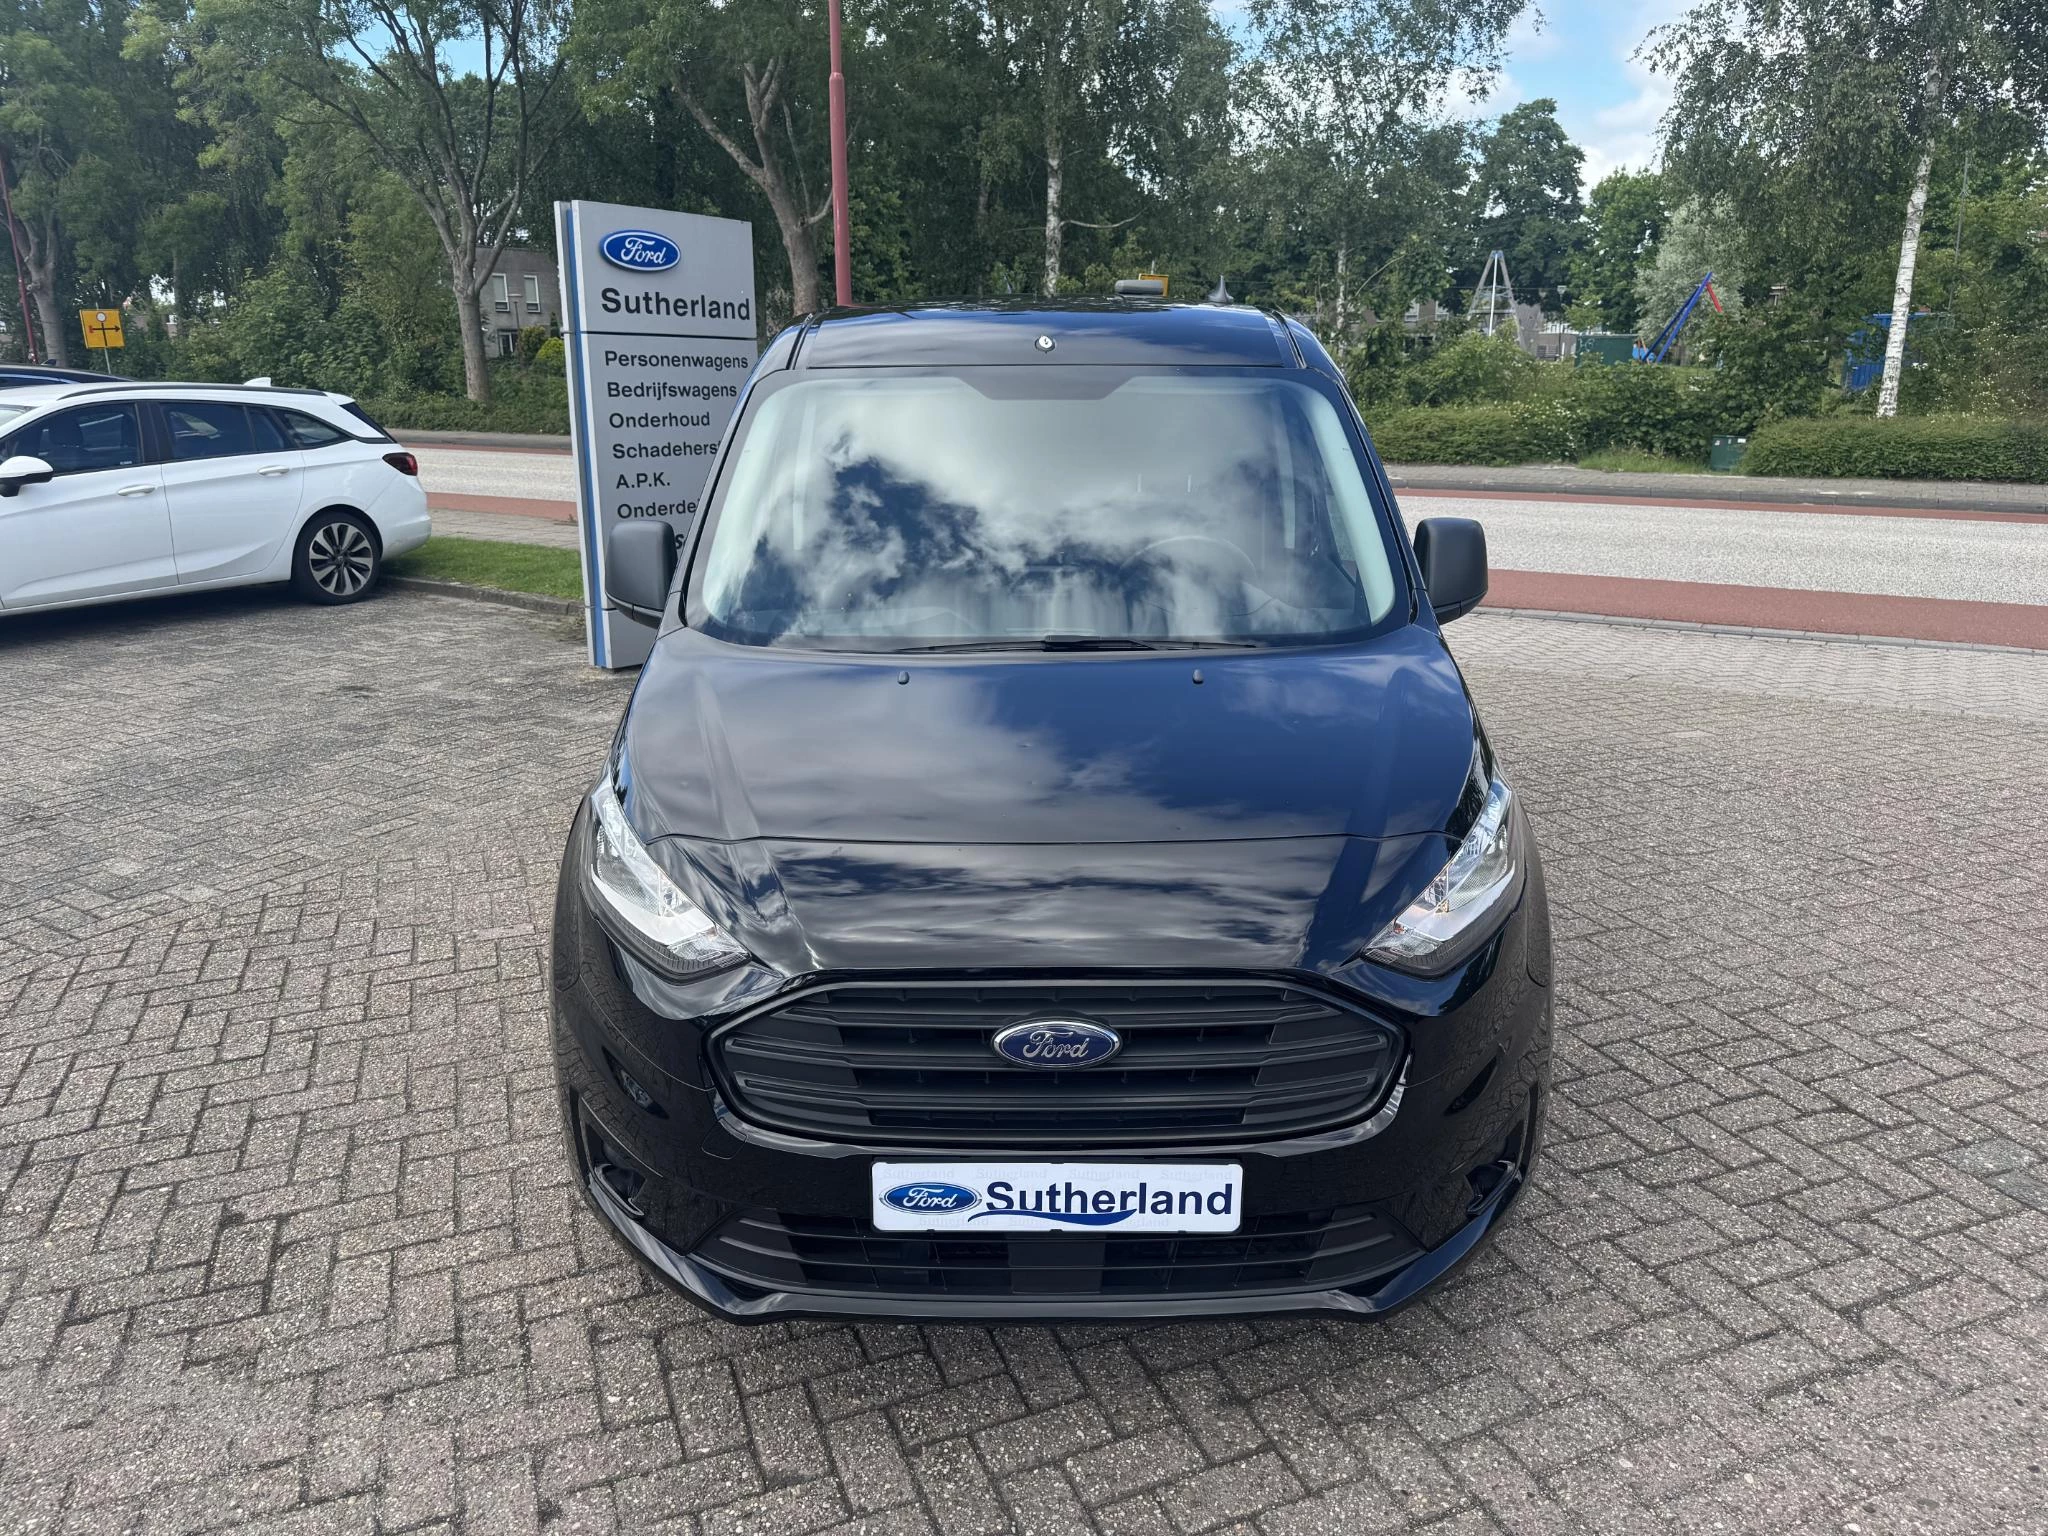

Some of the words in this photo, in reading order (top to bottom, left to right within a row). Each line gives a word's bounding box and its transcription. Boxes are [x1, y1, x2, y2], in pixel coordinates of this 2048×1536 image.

[620, 237, 666, 264] Ford
[601, 287, 750, 320] Sutherland
[604, 350, 749, 371] Personenwagens
[607, 382, 737, 400] Bedrijfswagens
[609, 411, 711, 429] Onderhoud
[616, 471, 671, 489] A.P.K.
[617, 499, 700, 519] Onderde
[1022, 1030, 1090, 1058] Ford
[902, 1187, 958, 1208] Ford
[985, 1181, 1233, 1215] Sutherland
